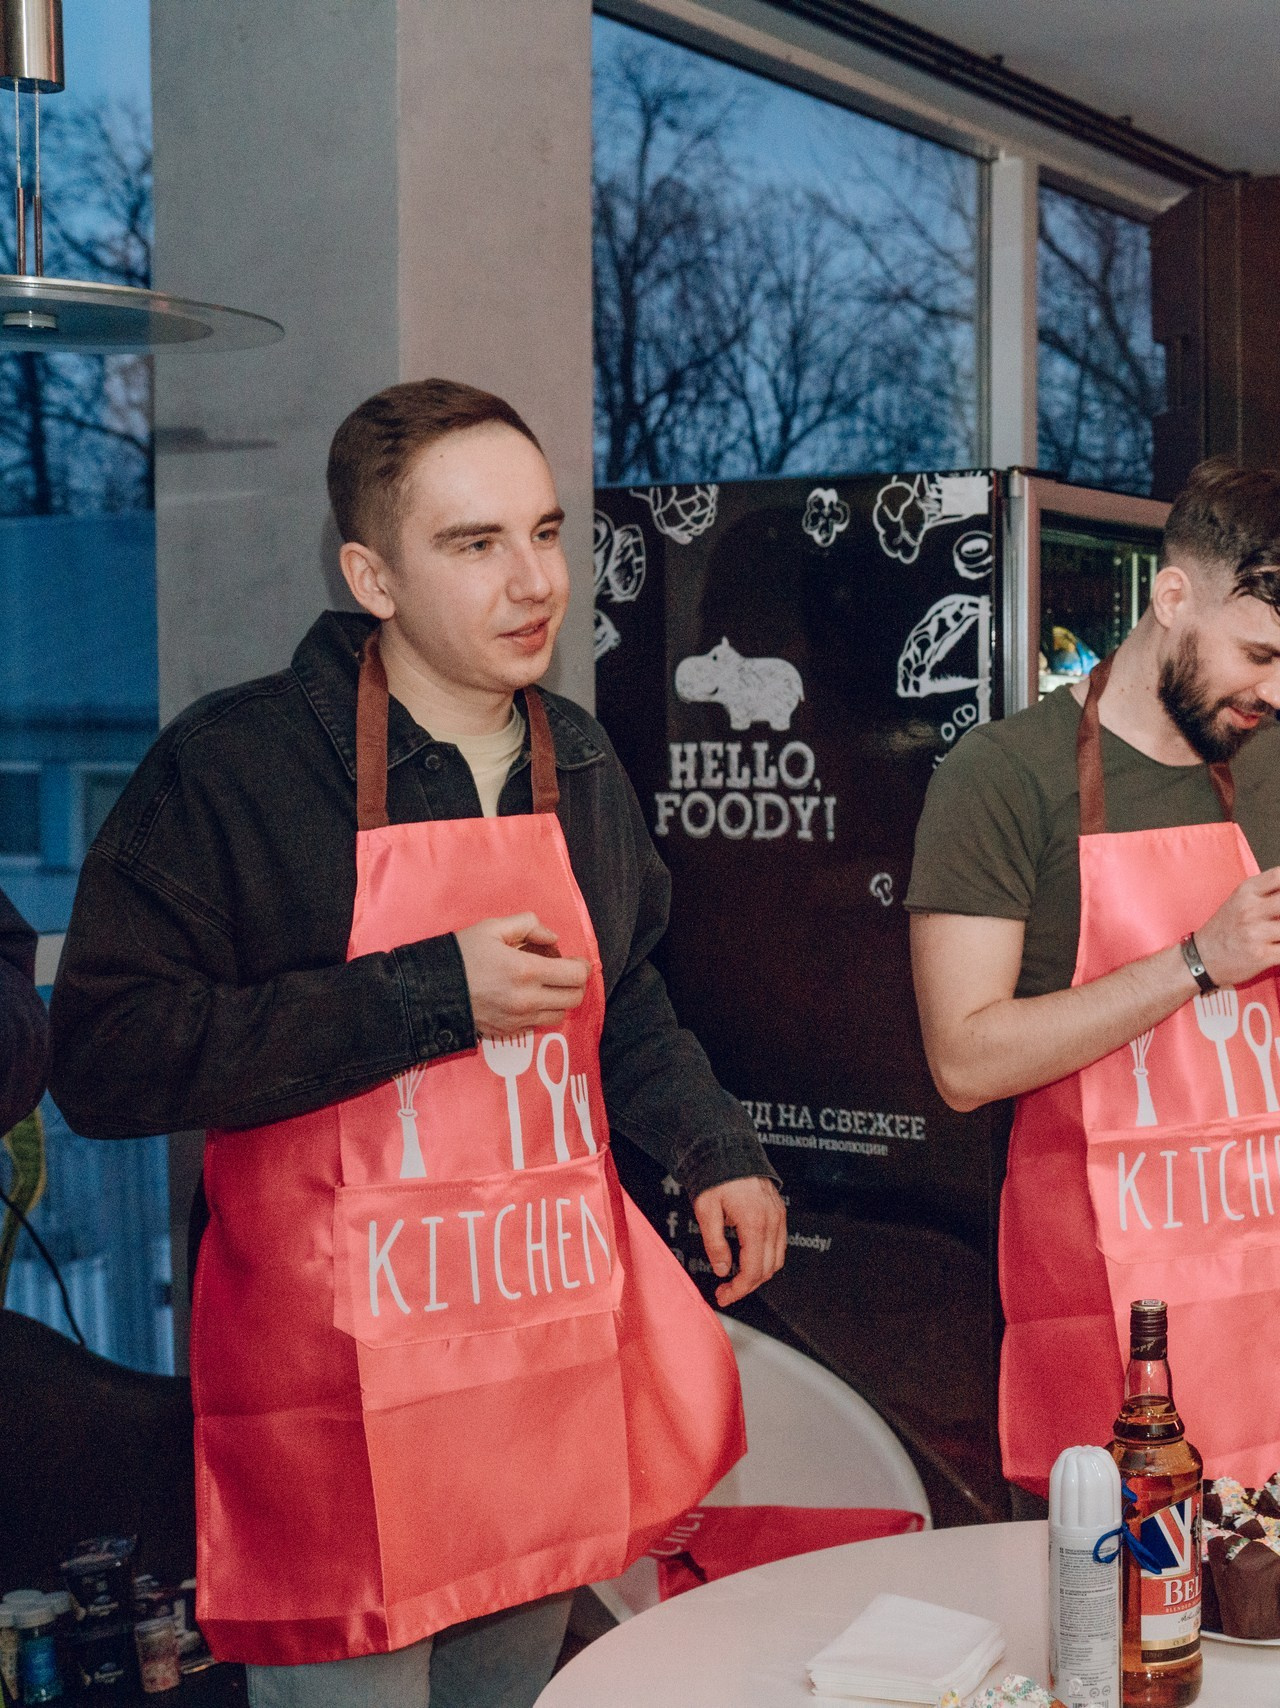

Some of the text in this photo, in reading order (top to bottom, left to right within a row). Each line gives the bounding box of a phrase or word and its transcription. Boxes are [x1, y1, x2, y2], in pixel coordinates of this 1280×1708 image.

[668, 741, 822, 792] HELLO,
[654, 791, 837, 841] FOODY!
[778, 1102, 814, 1132] НА
[819, 1107, 927, 1142] СВЕЖЕЕ
